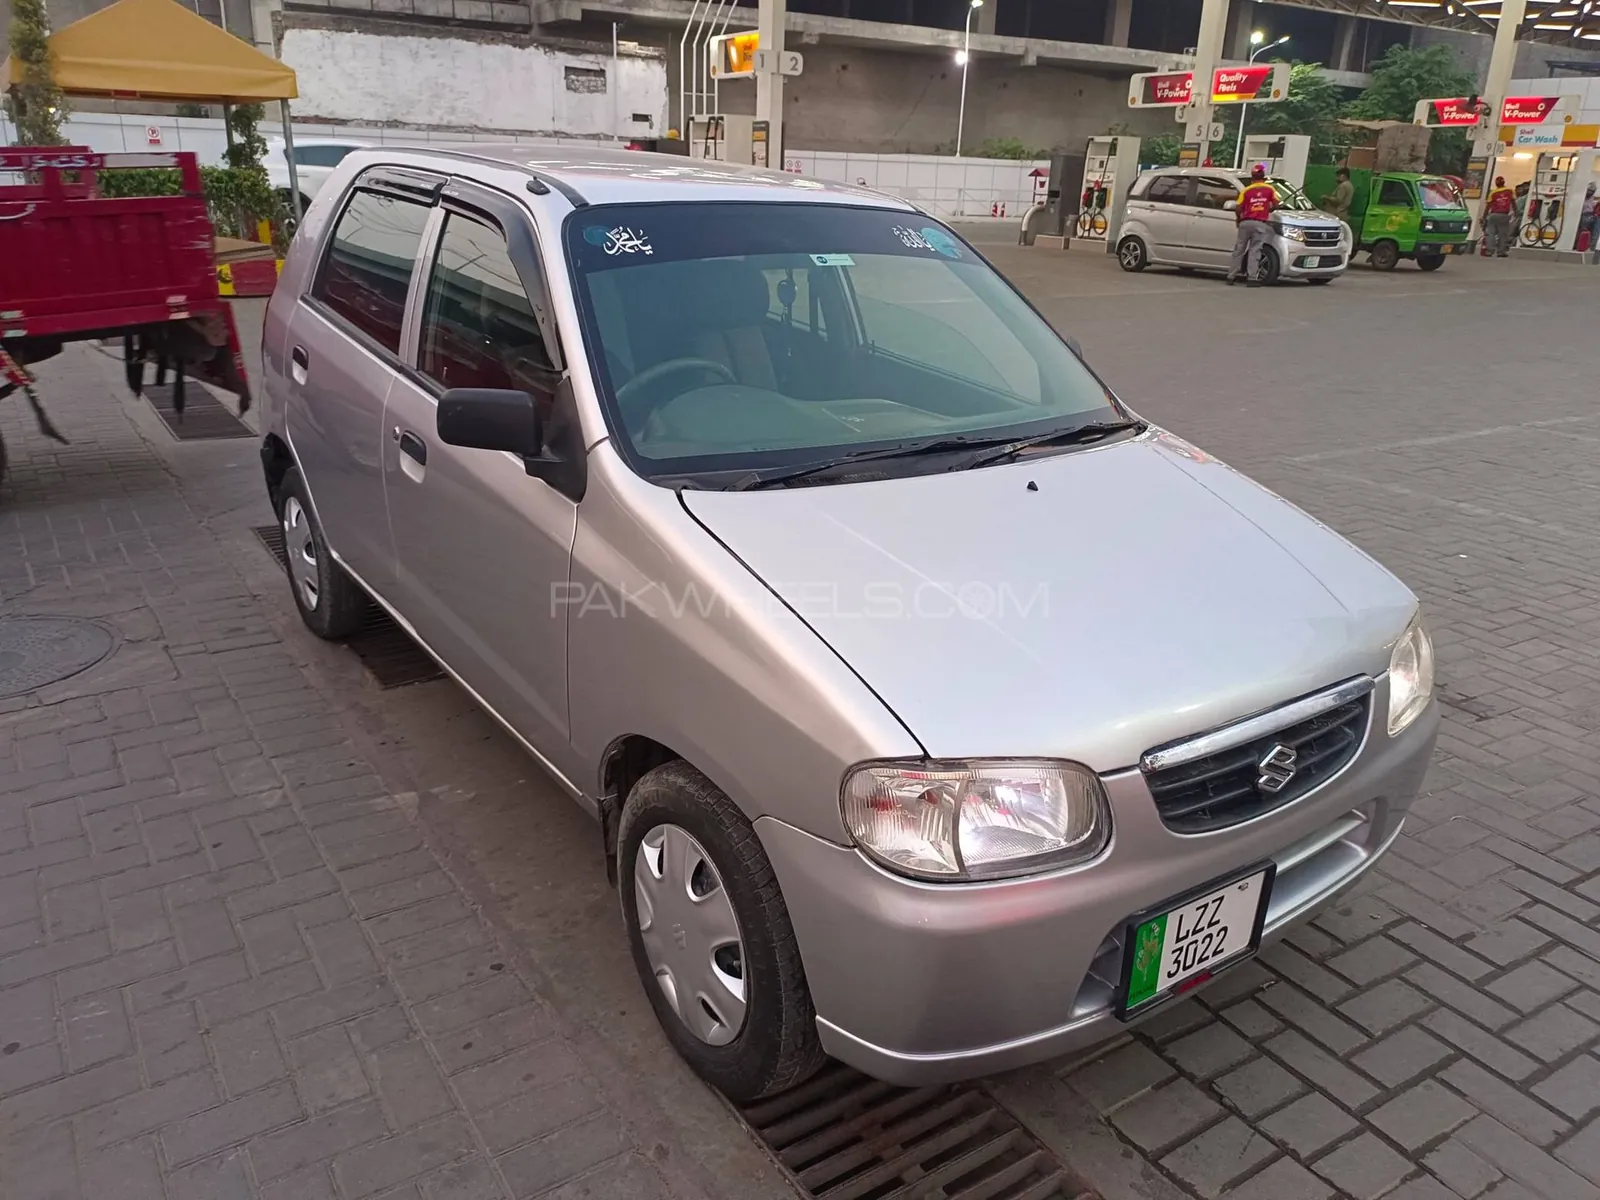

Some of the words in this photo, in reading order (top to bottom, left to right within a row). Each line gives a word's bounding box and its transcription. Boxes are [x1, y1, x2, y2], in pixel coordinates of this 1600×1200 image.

[759, 53, 765, 69] 1
[789, 56, 799, 72] 2
[1219, 72, 1248, 83] Quality
[1156, 88, 1189, 98] V-Power
[1443, 111, 1476, 120] V-Power
[1504, 110, 1541, 118] V-Power
[1195, 125, 1202, 137] 5
[1212, 127, 1219, 138] 6
[1518, 135, 1533, 144] Car
[1535, 135, 1558, 144] Wash
[1174, 894, 1226, 945] LZZ
[1166, 925, 1229, 979] 3022
